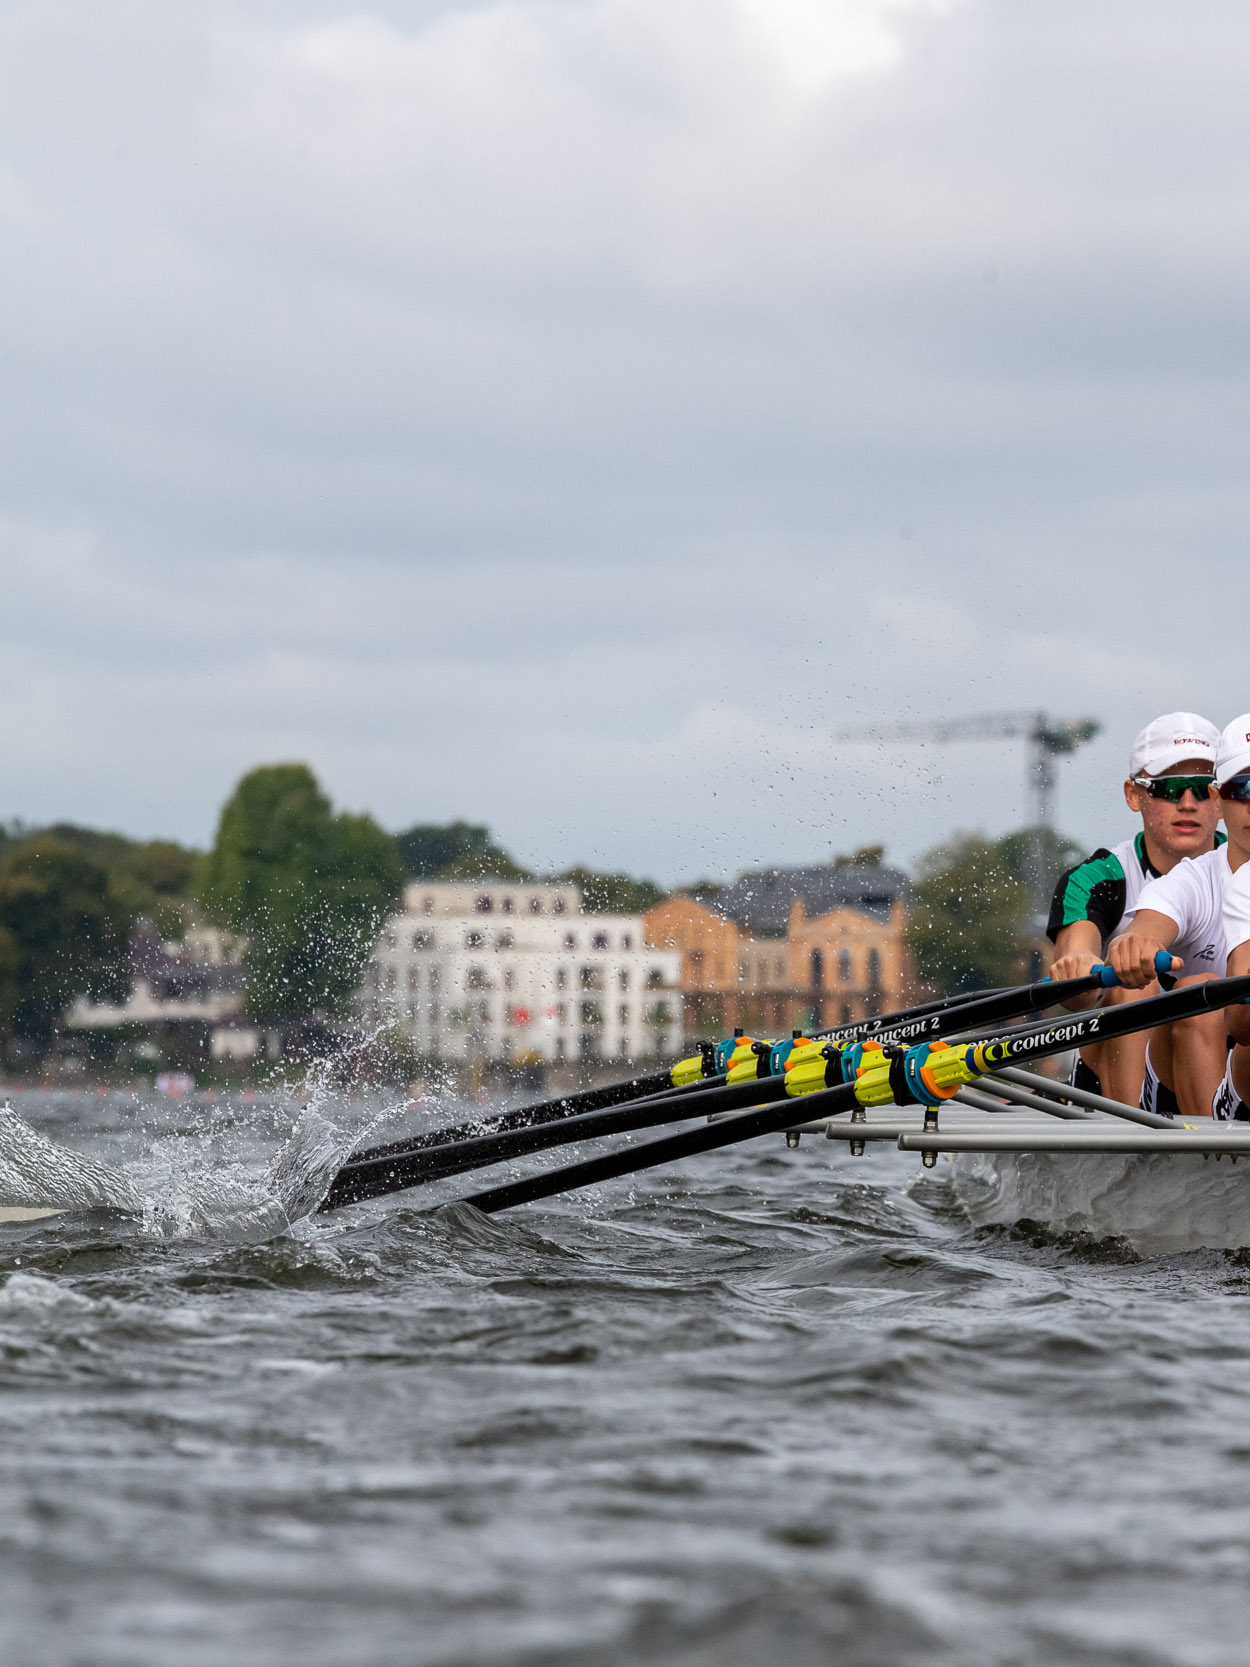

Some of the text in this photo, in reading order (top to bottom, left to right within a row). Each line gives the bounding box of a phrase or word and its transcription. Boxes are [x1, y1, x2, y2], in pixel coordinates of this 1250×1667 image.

[930, 1017, 940, 1029] 2
[1012, 1022, 1085, 1053] concept
[1089, 1018, 1100, 1032] 2
